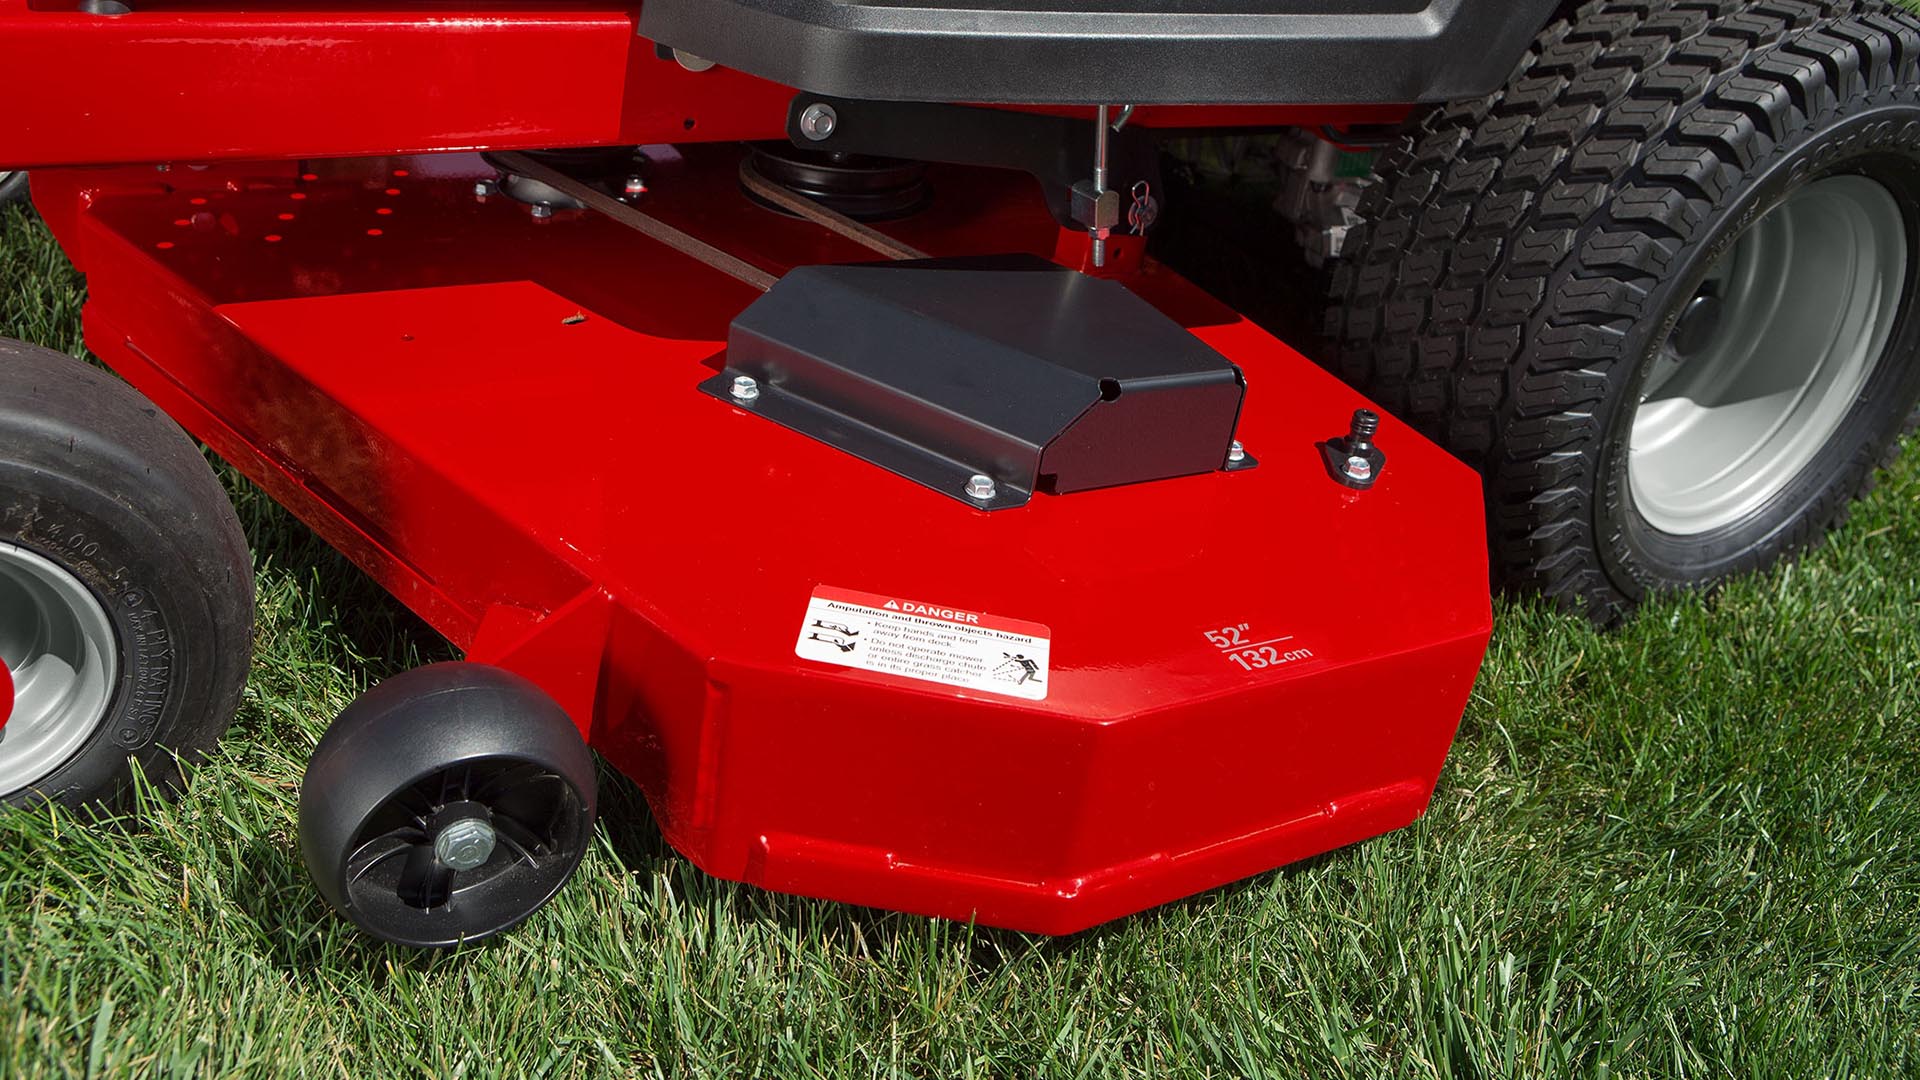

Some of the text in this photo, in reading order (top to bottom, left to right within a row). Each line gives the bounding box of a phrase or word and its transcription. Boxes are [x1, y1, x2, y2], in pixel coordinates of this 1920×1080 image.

[827, 602, 1032, 644] Amputation and thrown objects hazard
[902, 602, 980, 624] DANGER
[872, 630, 899, 639] away
[902, 633, 926, 642] from
[874, 621, 901, 632] Keep
[904, 627, 934, 637] hands
[959, 636, 978, 645] feet
[1203, 623, 1250, 648] 52"
[869, 645, 987, 671] unless discharge chute
[870, 638, 983, 663] Do not operate mower
[881, 654, 910, 664] entire
[913, 661, 942, 670] grass
[945, 666, 982, 677] catcher
[904, 667, 938, 677] proper
[138, 666, 169, 725] RATING
